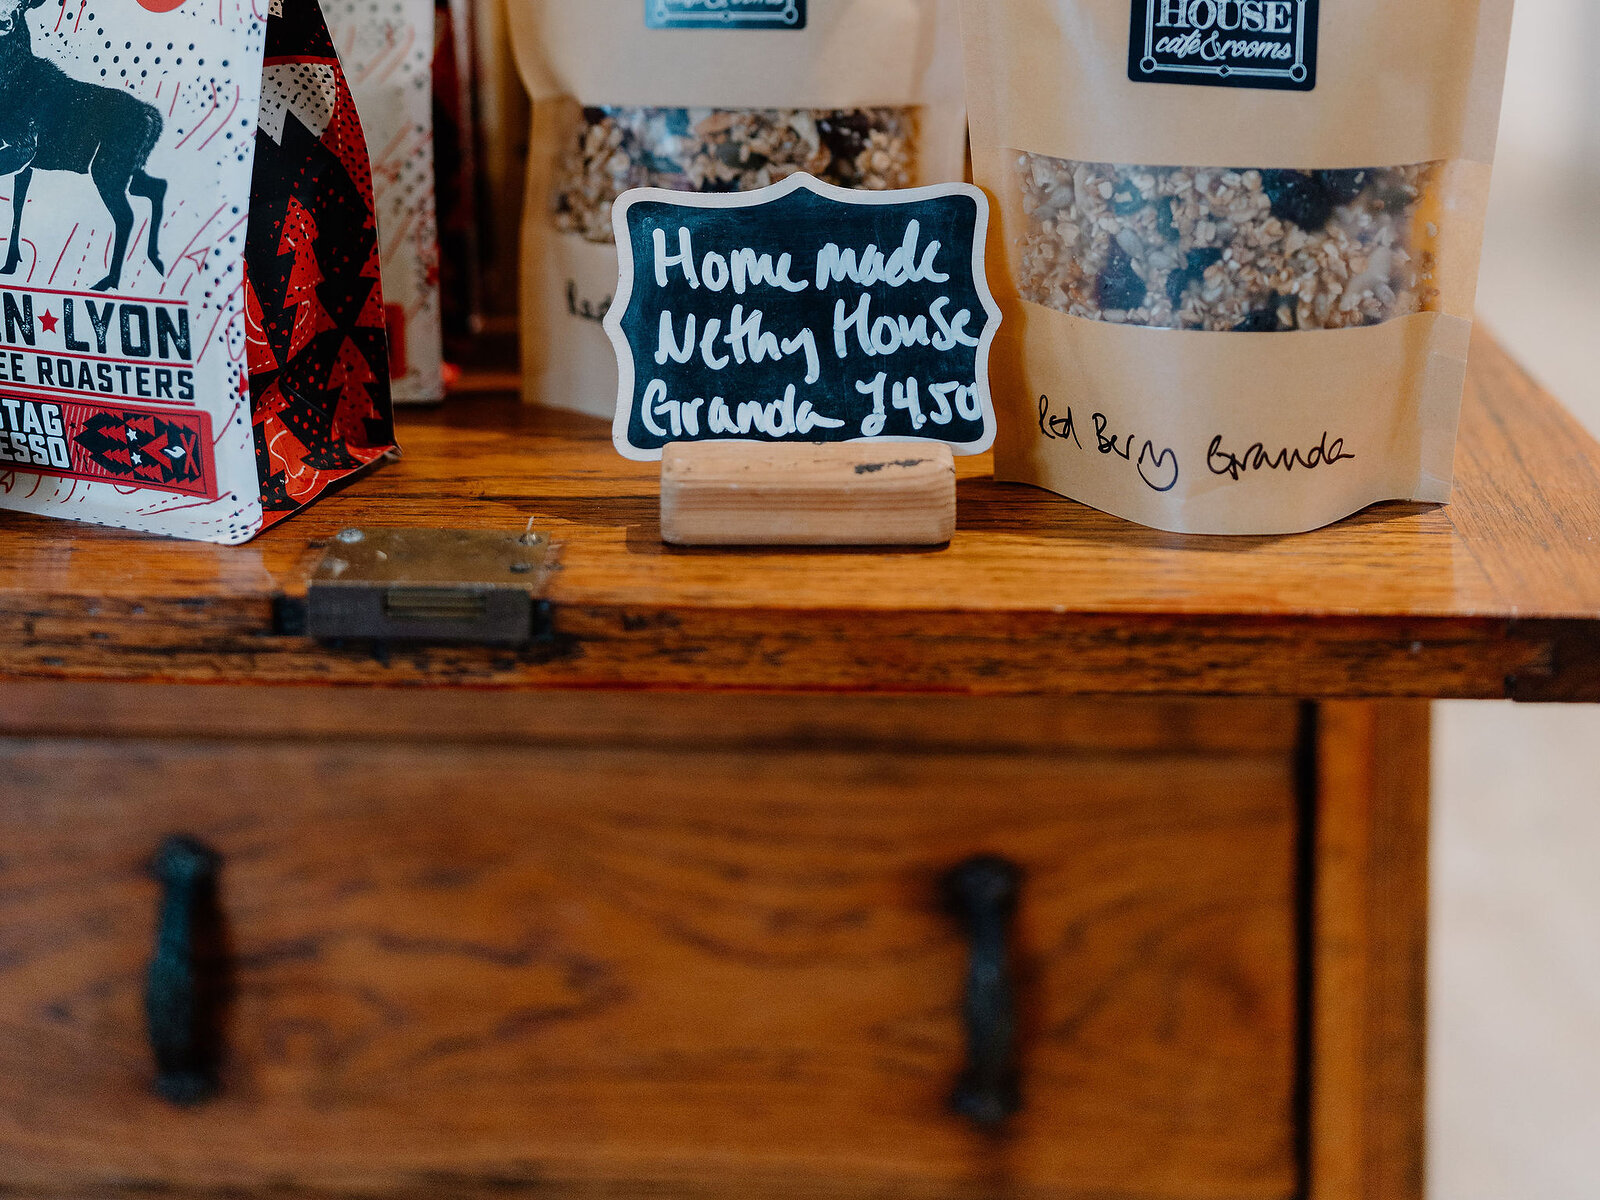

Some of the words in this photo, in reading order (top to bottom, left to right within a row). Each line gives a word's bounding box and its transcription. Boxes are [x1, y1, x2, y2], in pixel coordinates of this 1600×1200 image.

[63, 298, 192, 361] LYON
[655, 304, 820, 385] Nethy
[834, 292, 980, 359] House
[37, 356, 195, 400] ROASTERS
[0, 398, 63, 436] TAG
